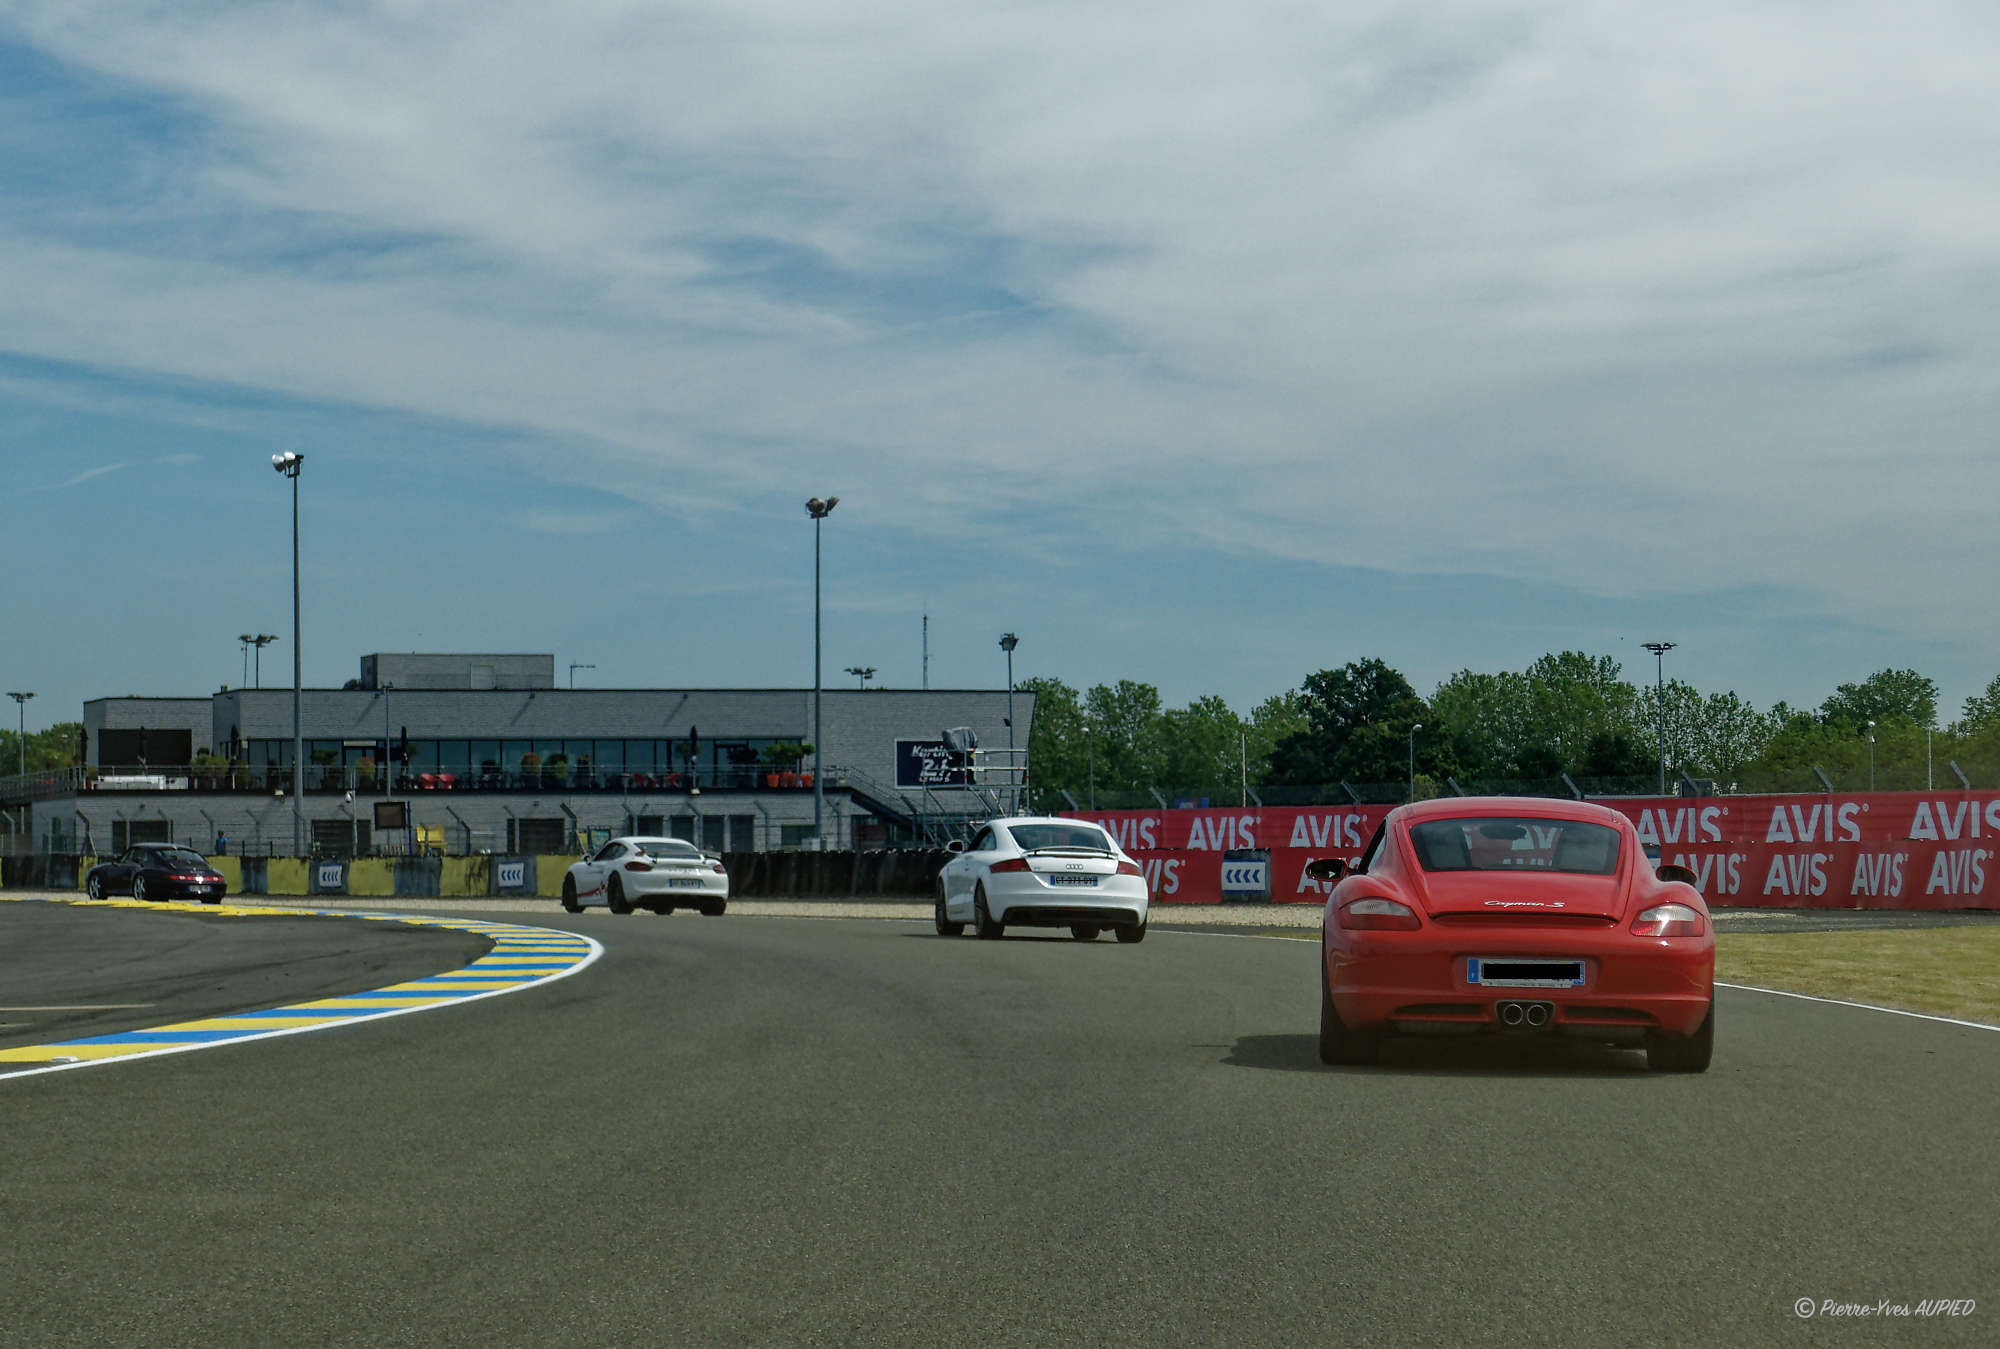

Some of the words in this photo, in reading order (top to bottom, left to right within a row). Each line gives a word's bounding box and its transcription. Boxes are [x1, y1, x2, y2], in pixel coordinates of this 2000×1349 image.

[1187, 816, 1256, 850] AVIS
[1289, 814, 1362, 848] AVIS
[1638, 806, 1723, 845] AVIS
[1765, 802, 1861, 843] AVIS
[1763, 853, 1828, 896] AVIS
[1851, 852, 1904, 897] AVIS
[1926, 849, 1988, 895] AVIS
[1484, 900, 1545, 908] Cayman
